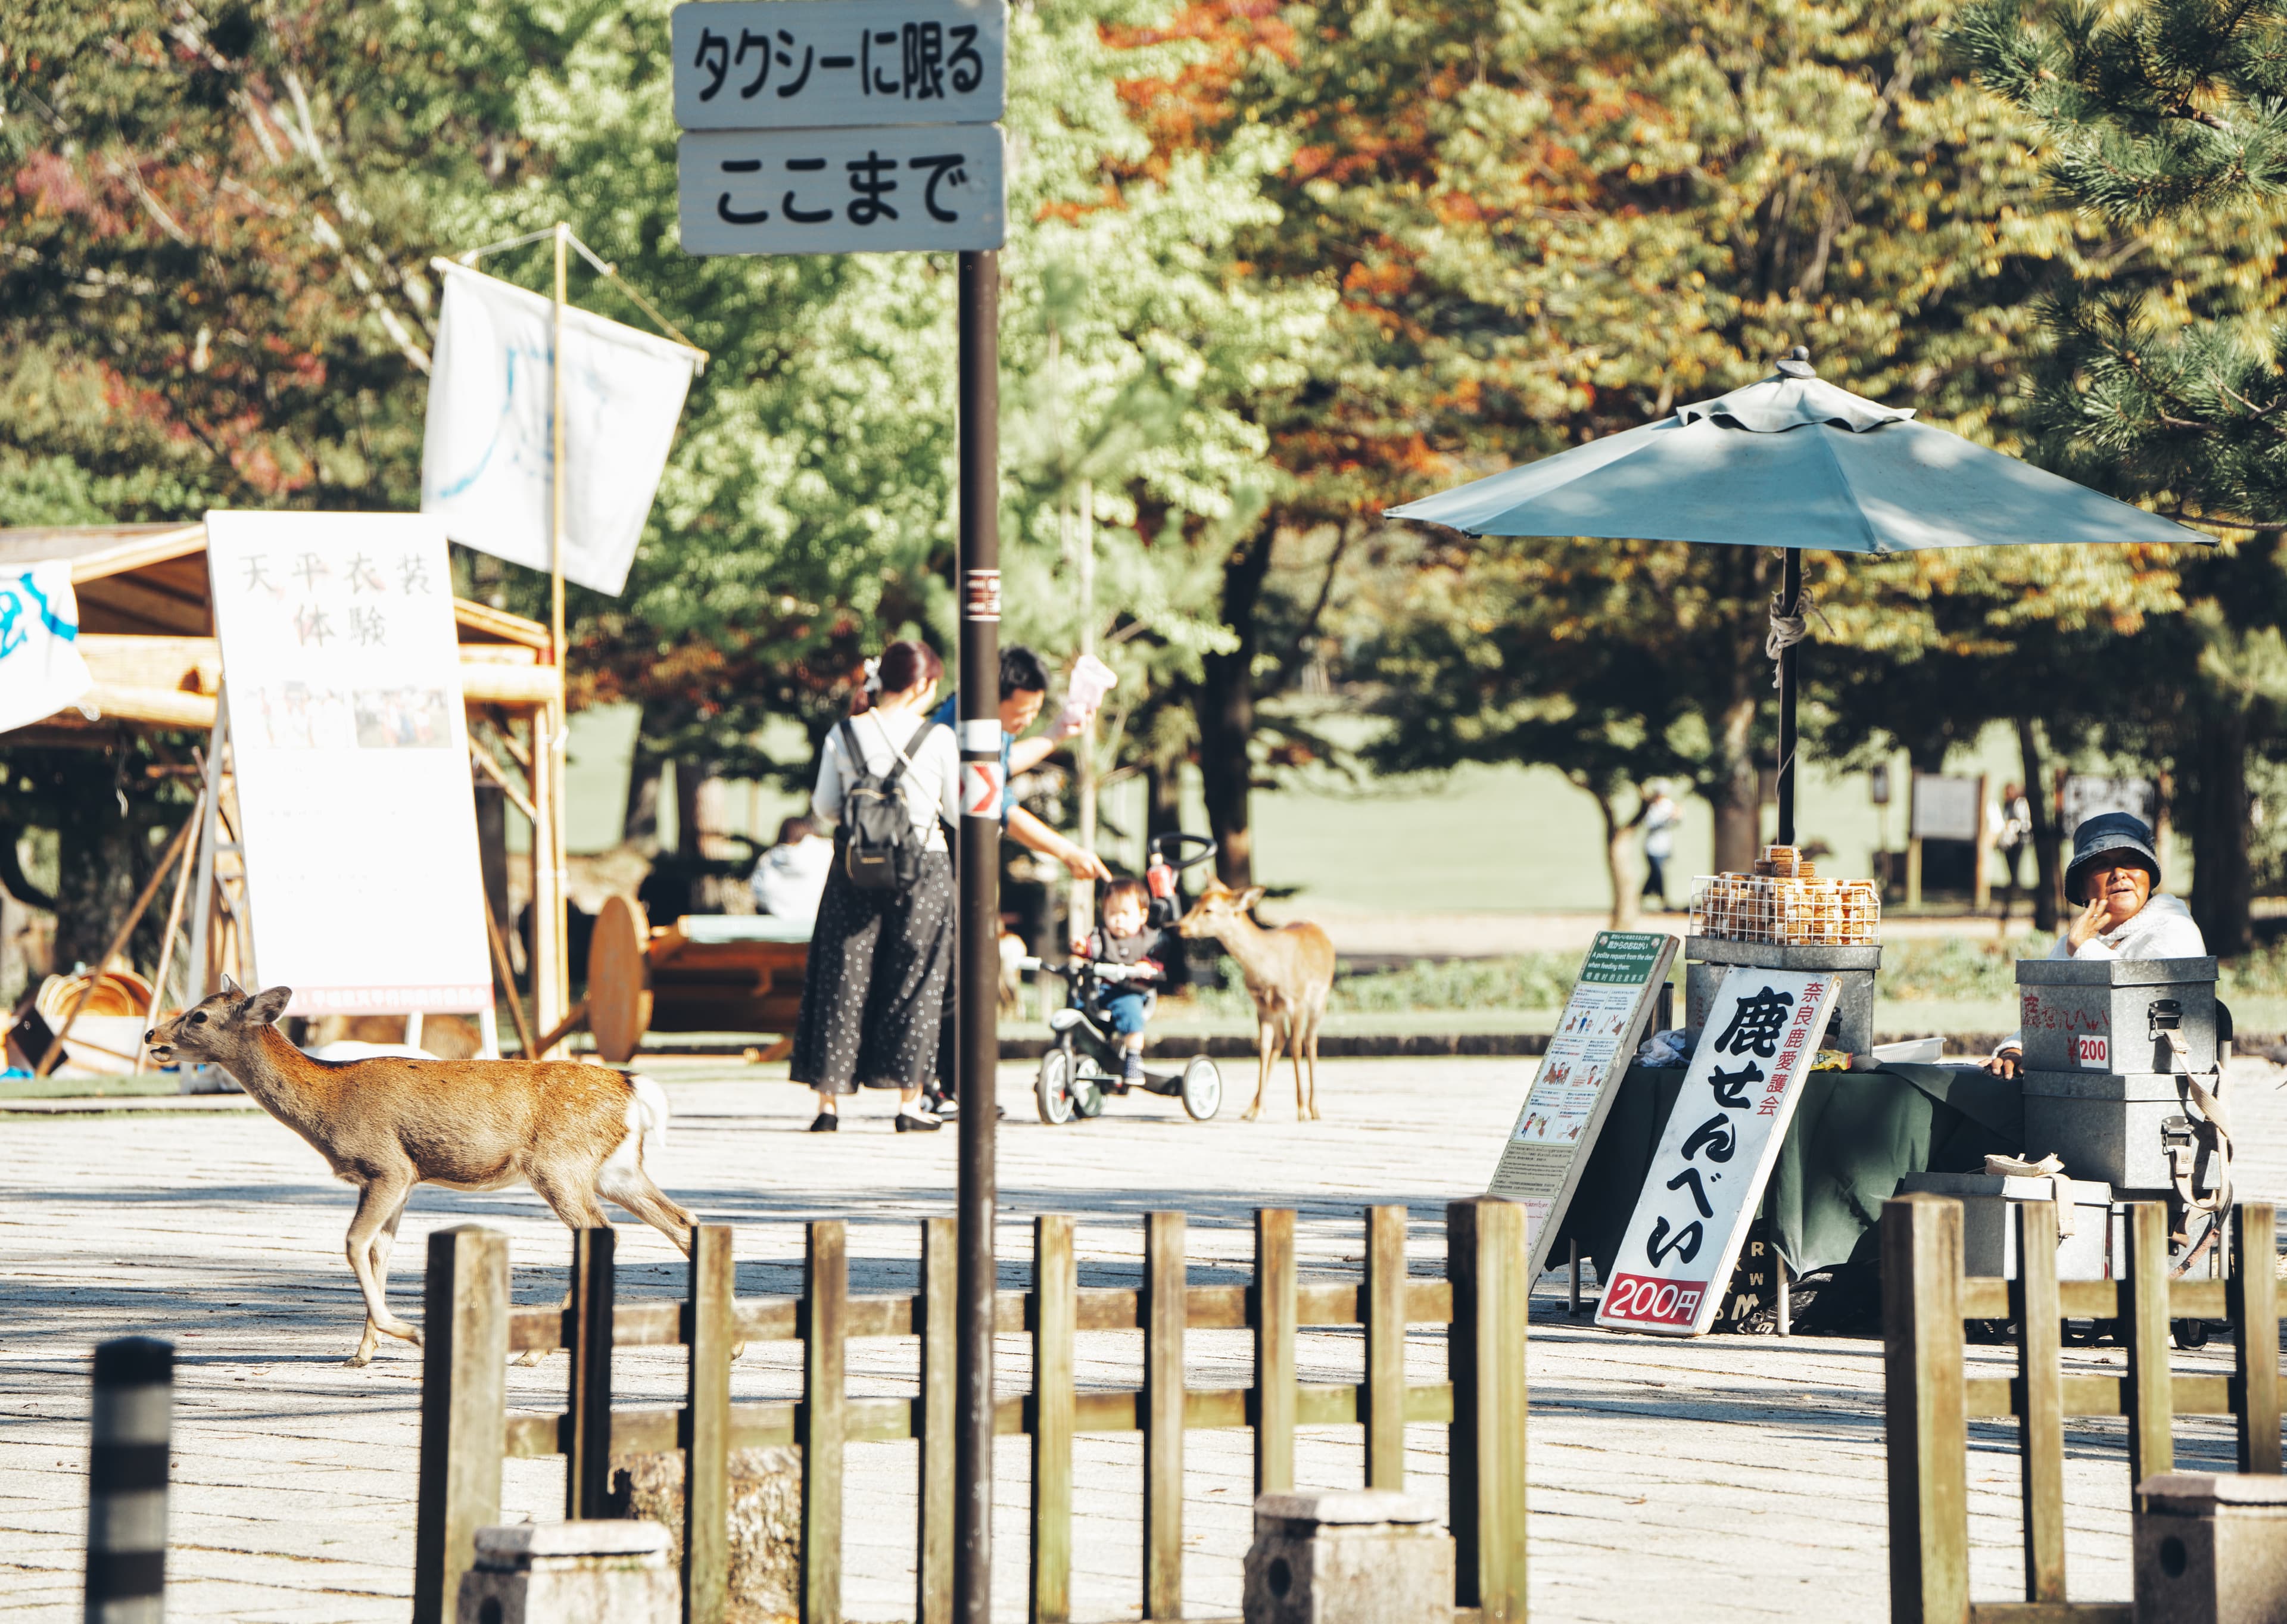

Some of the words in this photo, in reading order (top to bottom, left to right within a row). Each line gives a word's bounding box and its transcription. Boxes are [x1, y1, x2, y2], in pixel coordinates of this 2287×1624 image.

[694, 21, 983, 102] タクシーに限る
[718, 150, 968, 226] ここまで
[239, 551, 431, 596] 天平衣装
[294, 603, 387, 648] 体験
[1596, 952, 1609, 961] polite
[1600, 962, 1618, 971] feeding
[1757, 981, 1825, 1117] 奈良鹿愛護会
[1646, 986, 1794, 1269] 鹿せんべい
[1751, 1242, 1764, 1257] R
[1609, 1279, 1701, 1321] 200円
[1749, 1273, 1764, 1286] W
